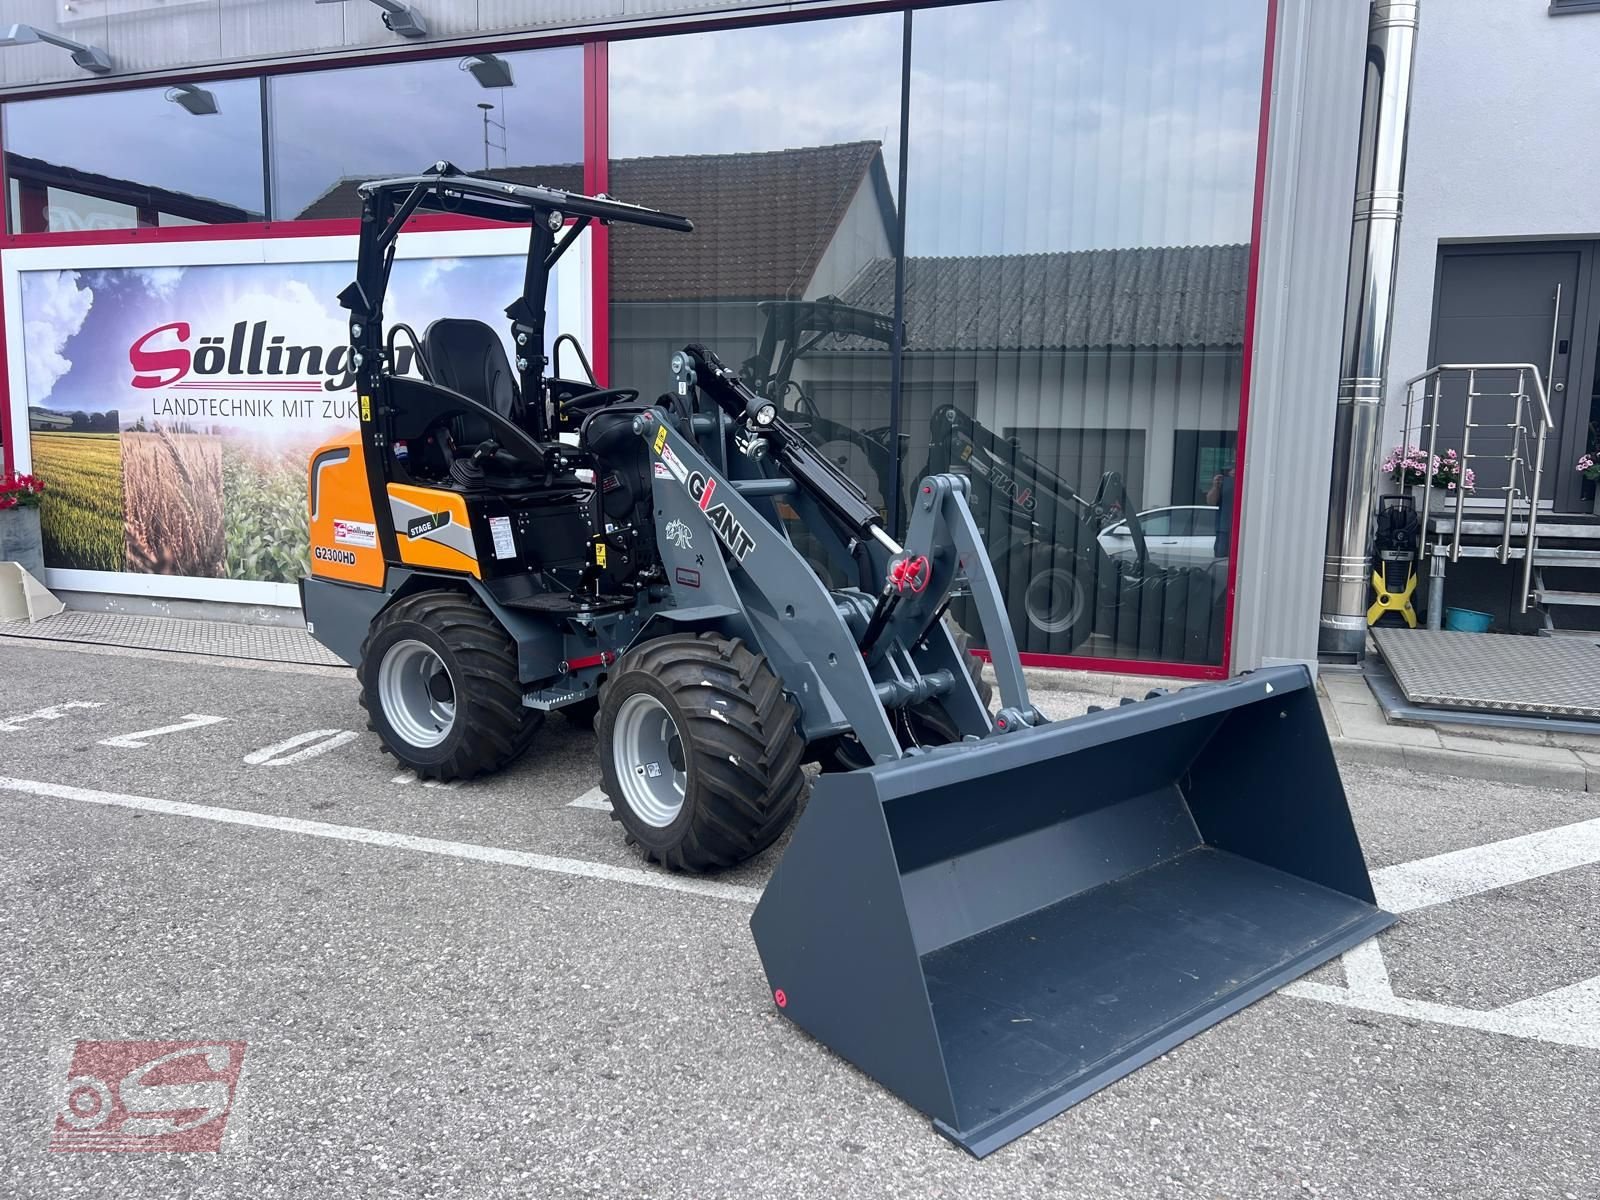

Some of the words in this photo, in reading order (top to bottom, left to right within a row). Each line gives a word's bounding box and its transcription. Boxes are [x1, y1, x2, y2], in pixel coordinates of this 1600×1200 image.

[129, 320, 422, 391] Söllingr
[153, 398, 273, 418] LANDTECHNIK
[282, 400, 315, 419] MIT
[410, 521, 433, 536] STAGE
[314, 546, 357, 566] G2300HD
